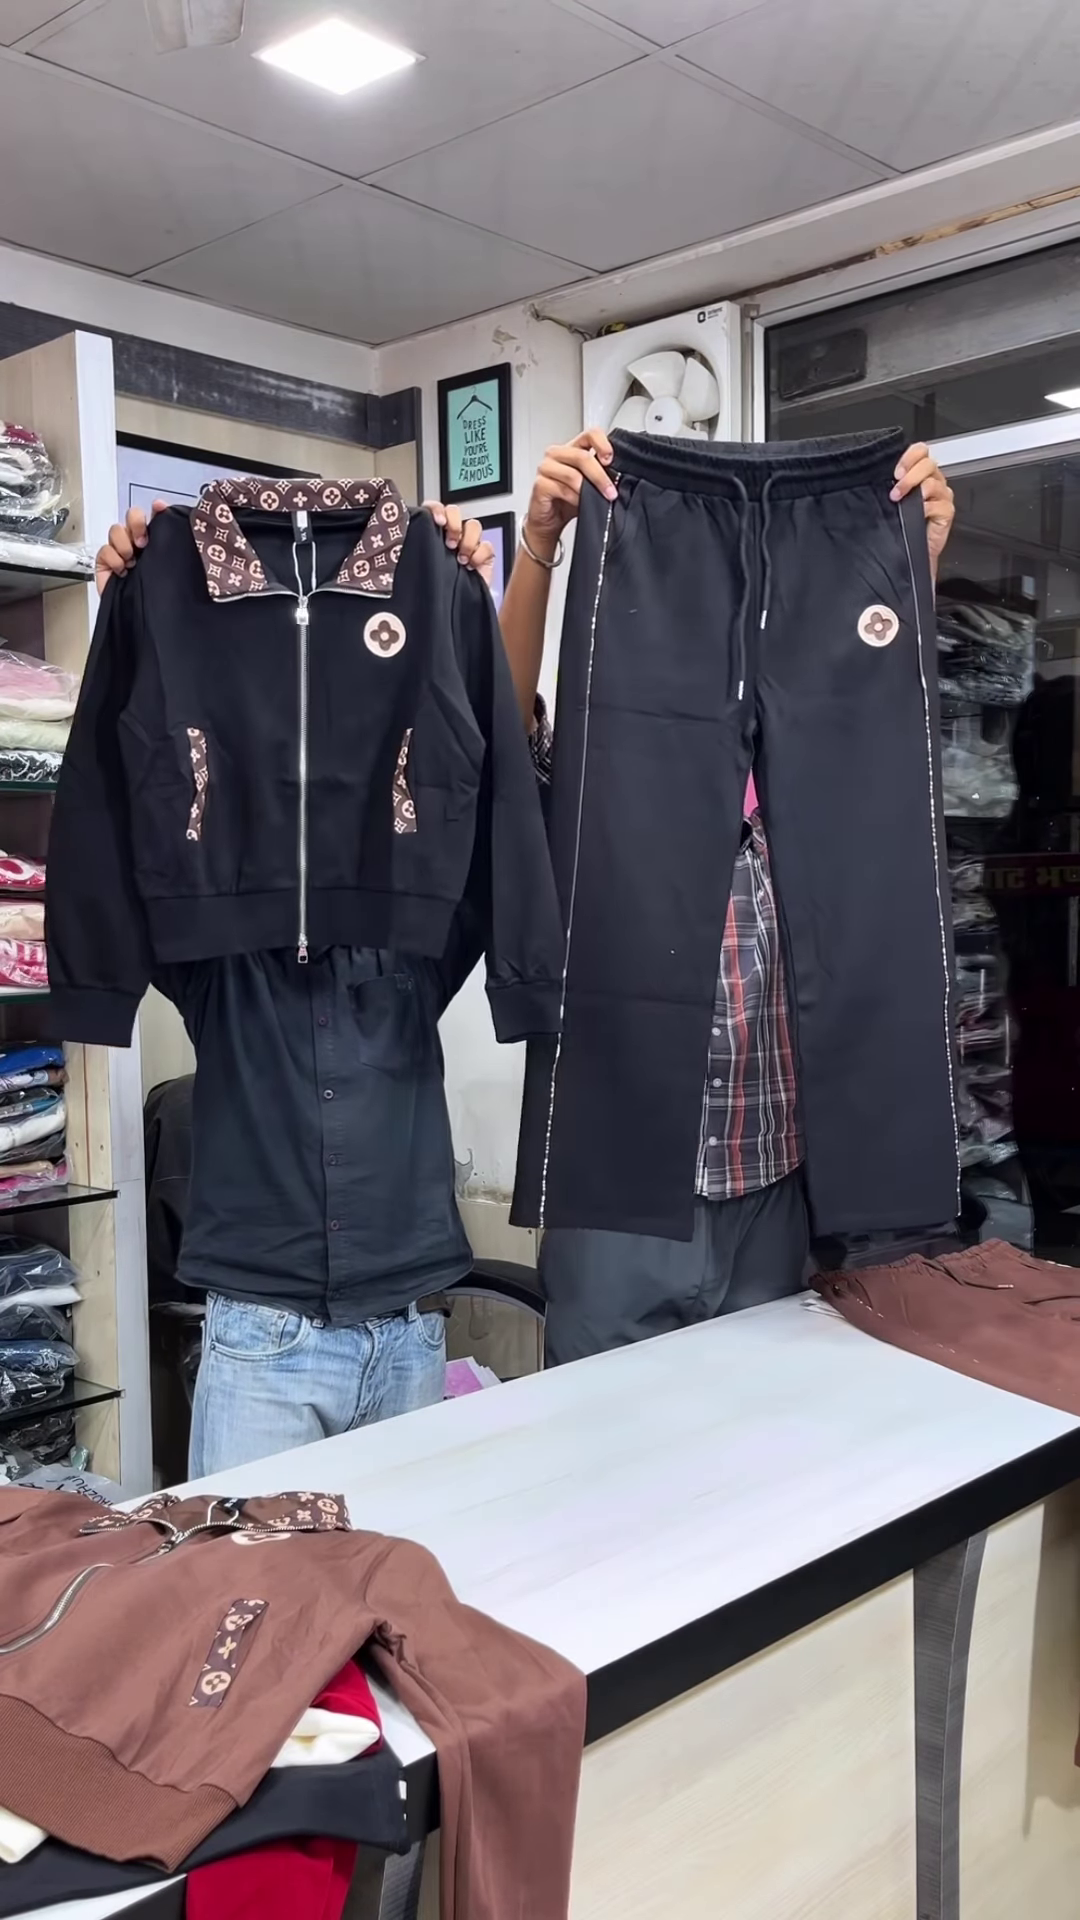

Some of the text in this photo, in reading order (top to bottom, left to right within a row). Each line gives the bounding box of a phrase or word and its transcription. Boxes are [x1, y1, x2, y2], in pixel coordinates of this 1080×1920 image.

[463, 416, 486, 430] DRESS
[465, 428, 486, 444] LIKE
[462, 454, 490, 467] ALREADY
[459, 464, 494, 482] FAMOUS
